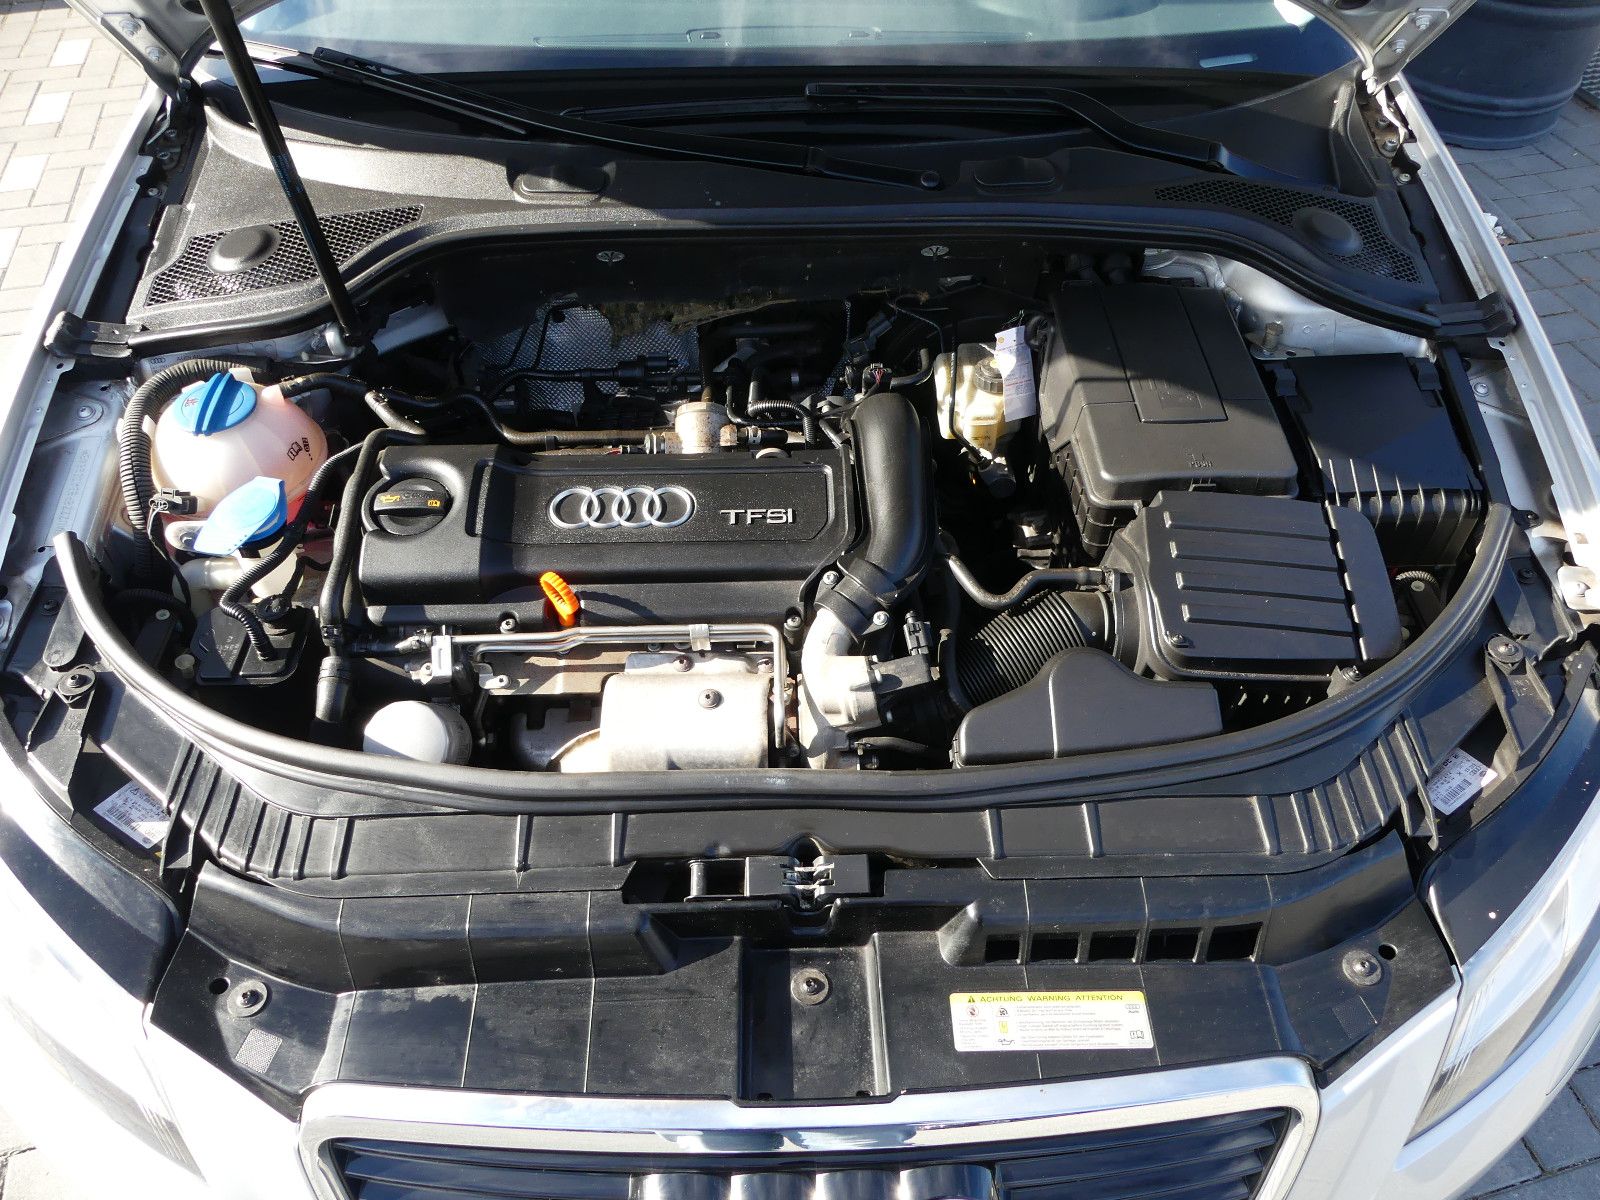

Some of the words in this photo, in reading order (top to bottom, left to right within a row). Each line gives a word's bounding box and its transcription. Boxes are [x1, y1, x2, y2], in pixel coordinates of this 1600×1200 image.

[720, 508, 793, 525] TFSI
[980, 995, 1023, 1003] ACHTUNG
[1075, 994, 1124, 1002] ATTENTION
